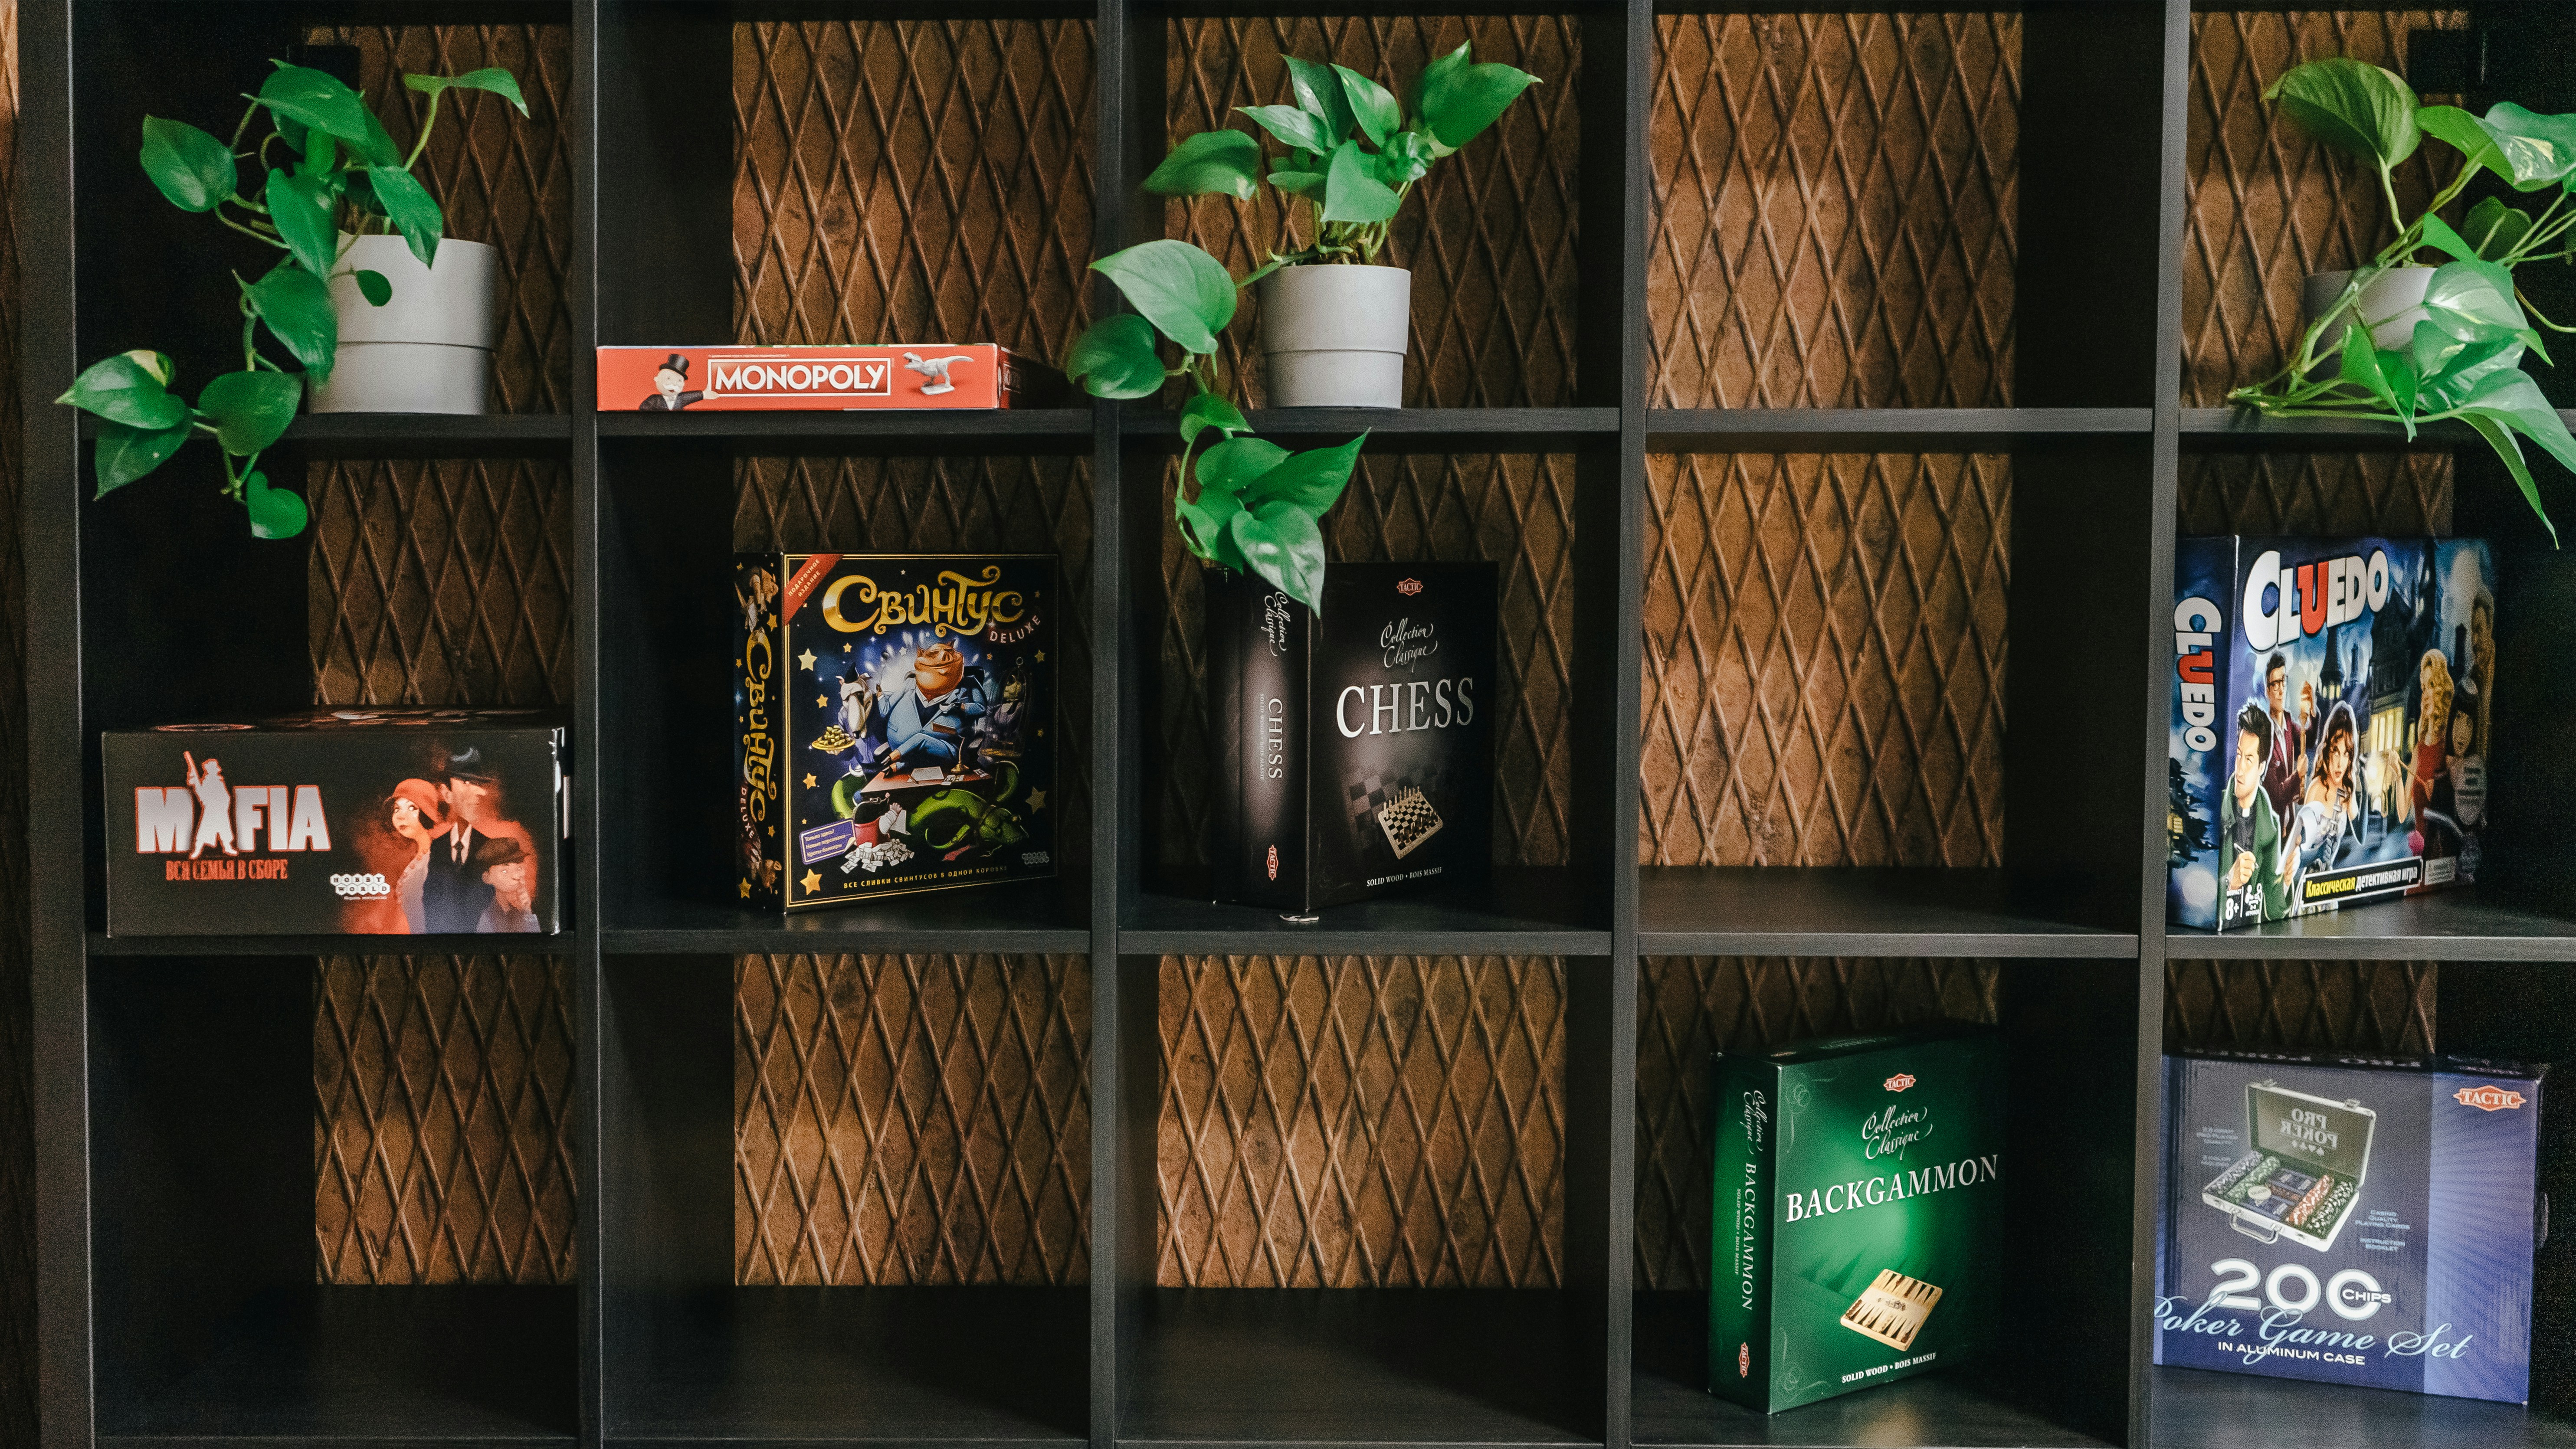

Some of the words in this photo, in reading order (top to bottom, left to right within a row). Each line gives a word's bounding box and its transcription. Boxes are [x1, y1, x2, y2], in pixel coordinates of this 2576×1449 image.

[715, 364, 885, 390] MONOPOLY
[788, 559, 820, 596] ПОДАРОЧНОЕ
[798, 570, 820, 597] ИЗДАНИЕ
[1399, 582, 1420, 592] TACTIC
[2243, 550, 2389, 651] CLUEDO
[989, 615, 1041, 643] DELUXE
[1260, 595, 1278, 657] Classique
[1275, 591, 1291, 652] Collection
[1380, 617, 1433, 648] Collection
[1383, 640, 1438, 673] Classique
[2173, 597, 2222, 752] CLUEDO
[1336, 677, 1474, 738] CHESS
[1268, 698, 1283, 778] CHESS
[740, 786, 755, 838] DELUXE
[166, 860, 190, 880] ВСЯ
[192, 860, 235, 880] СЕМЬЯ
[238, 860, 246, 880] В
[249, 859, 288, 880] СБОРЕ
[861, 878, 891, 887] СЛИВКИ
[894, 873, 938, 883] СВИНТУСОВ
[948, 868, 973, 877] ОДНОЙ
[1367, 876, 1385, 887] SOLID
[1386, 873, 1404, 884] WOOD
[1409, 870, 1422, 880] BOIS
[1424, 867, 1442, 877] MASSIF
[2305, 877, 2356, 898] Классическая
[2356, 868, 2402, 892] детективная
[2402, 867, 2418, 883] игра
[2225, 898, 2239, 920] 8+
[1887, 1076, 1914, 1090] TACTIC
[2461, 1091, 2518, 1107] TACTIC
[1740, 1091, 1754, 1155] Classique
[1753, 1090, 1768, 1151] Collection
[1862, 1105, 1927, 1140] Collection
[1865, 1124, 1933, 1160] Classique
[1786, 1154, 1998, 1223] BACKGAMMON
[1743, 1162, 1757, 1310] BACKGAMMON
[2209, 1258, 2384, 1320] 200
[2342, 1289, 2392, 1305] CHIPS
[2243, 1305, 2376, 1365] Game
[2384, 1322, 2474, 1360] Set
[1842, 1370, 1864, 1383] SOLID
[1865, 1365, 1888, 1377] WOOD
[1894, 1359, 1911, 1369] BOIS
[1913, 1352, 1937, 1364] MASSIF
[2217, 1341, 2233, 1352] IN
[2236, 1343, 2320, 1362] ALUMINUM
[2323, 1351, 2366, 1366] CASE
